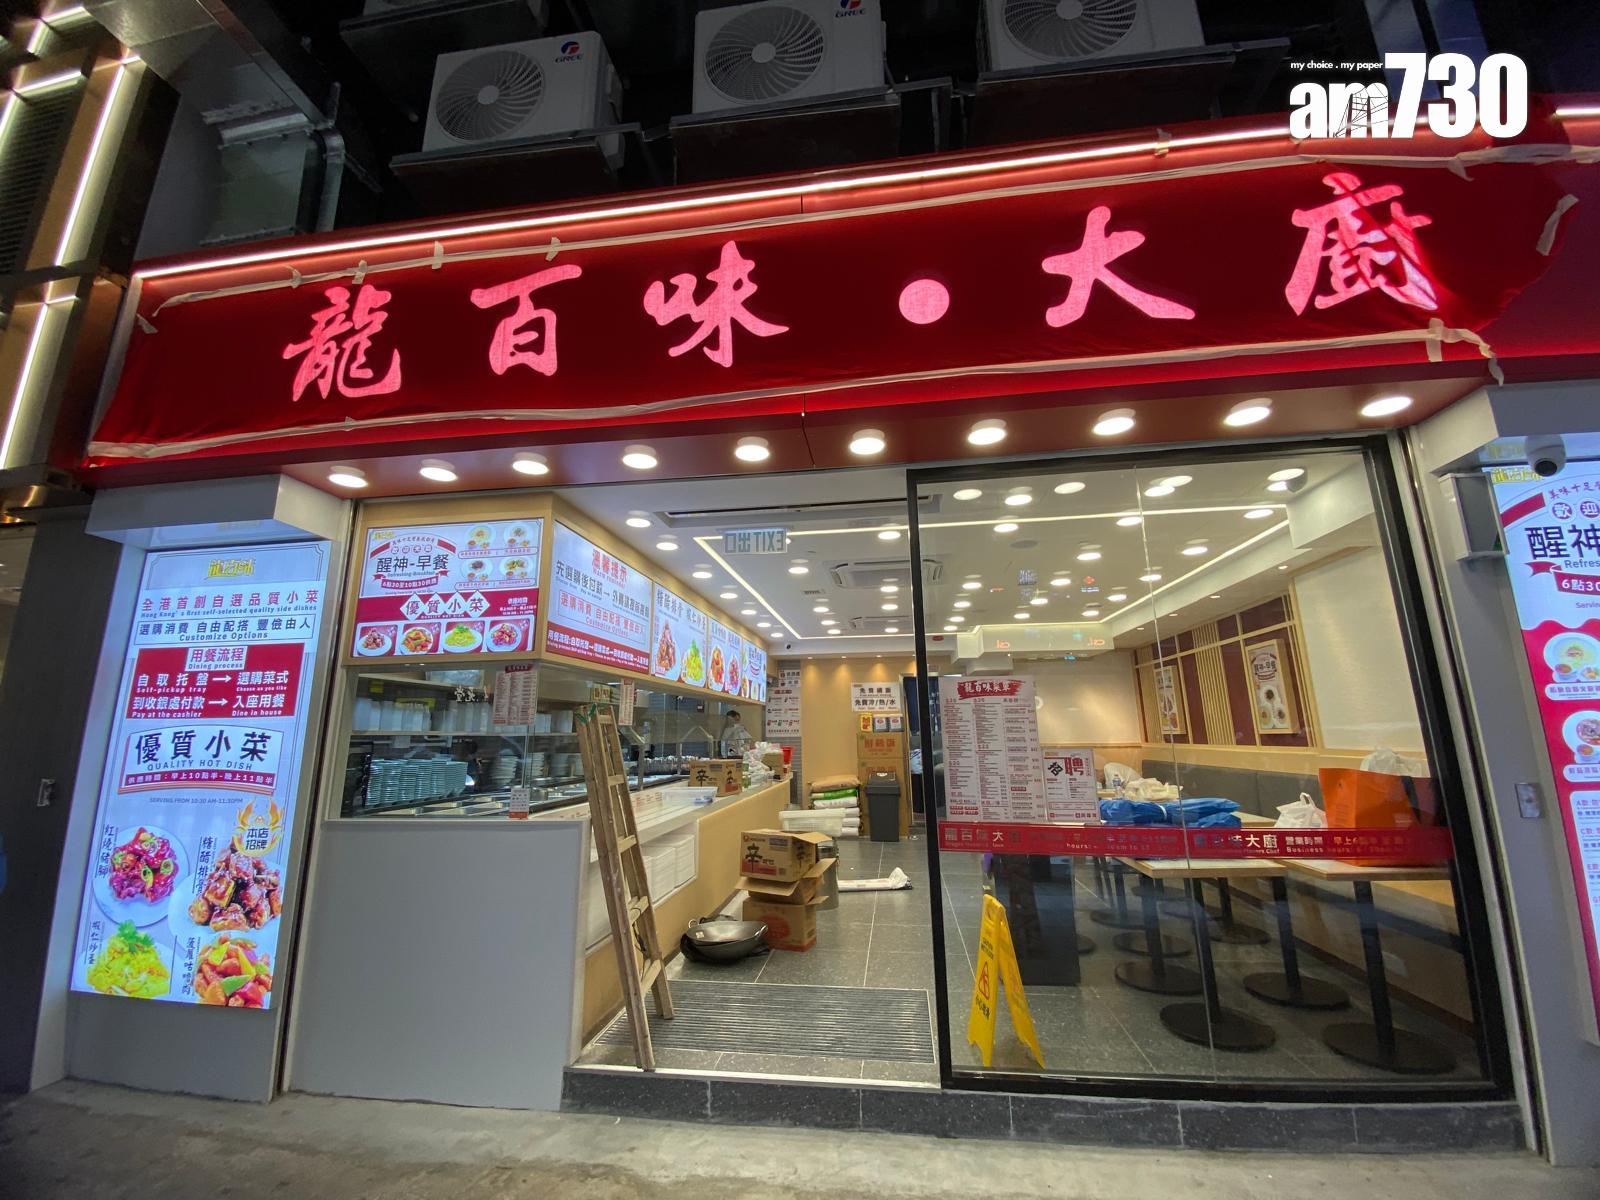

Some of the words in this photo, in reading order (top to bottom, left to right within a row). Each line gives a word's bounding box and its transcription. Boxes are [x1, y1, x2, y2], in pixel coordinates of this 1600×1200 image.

[376, 554, 449, 573] 醒神-早餐
[141, 589, 319, 612] 全港首創自選品質小菜
[406, 597, 484, 616] 優質小菜
[139, 622, 189, 636] 選購消費
[197, 620, 249, 634] 自由配搭
[257, 617, 311, 631] 豐儉由人
[179, 633, 228, 642] Customize
[231, 631, 268, 641] Options
[190, 647, 244, 662] 用餐流程
[188, 663, 212, 671] Dining
[214, 663, 243, 671] process
[137, 672, 209, 687] 自取托盤
[236, 670, 289, 685] 選購菜式
[132, 696, 204, 710] 到收銀處付款
[232, 694, 286, 709] 入座用餐
[135, 729, 272, 765] 優質小菜
[147, 759, 194, 771] QUALITY
[200, 759, 221, 767] HOT
[226, 760, 253, 770] DISH
[247, 828, 269, 839] 本店
[246, 840, 268, 851] 招牌
